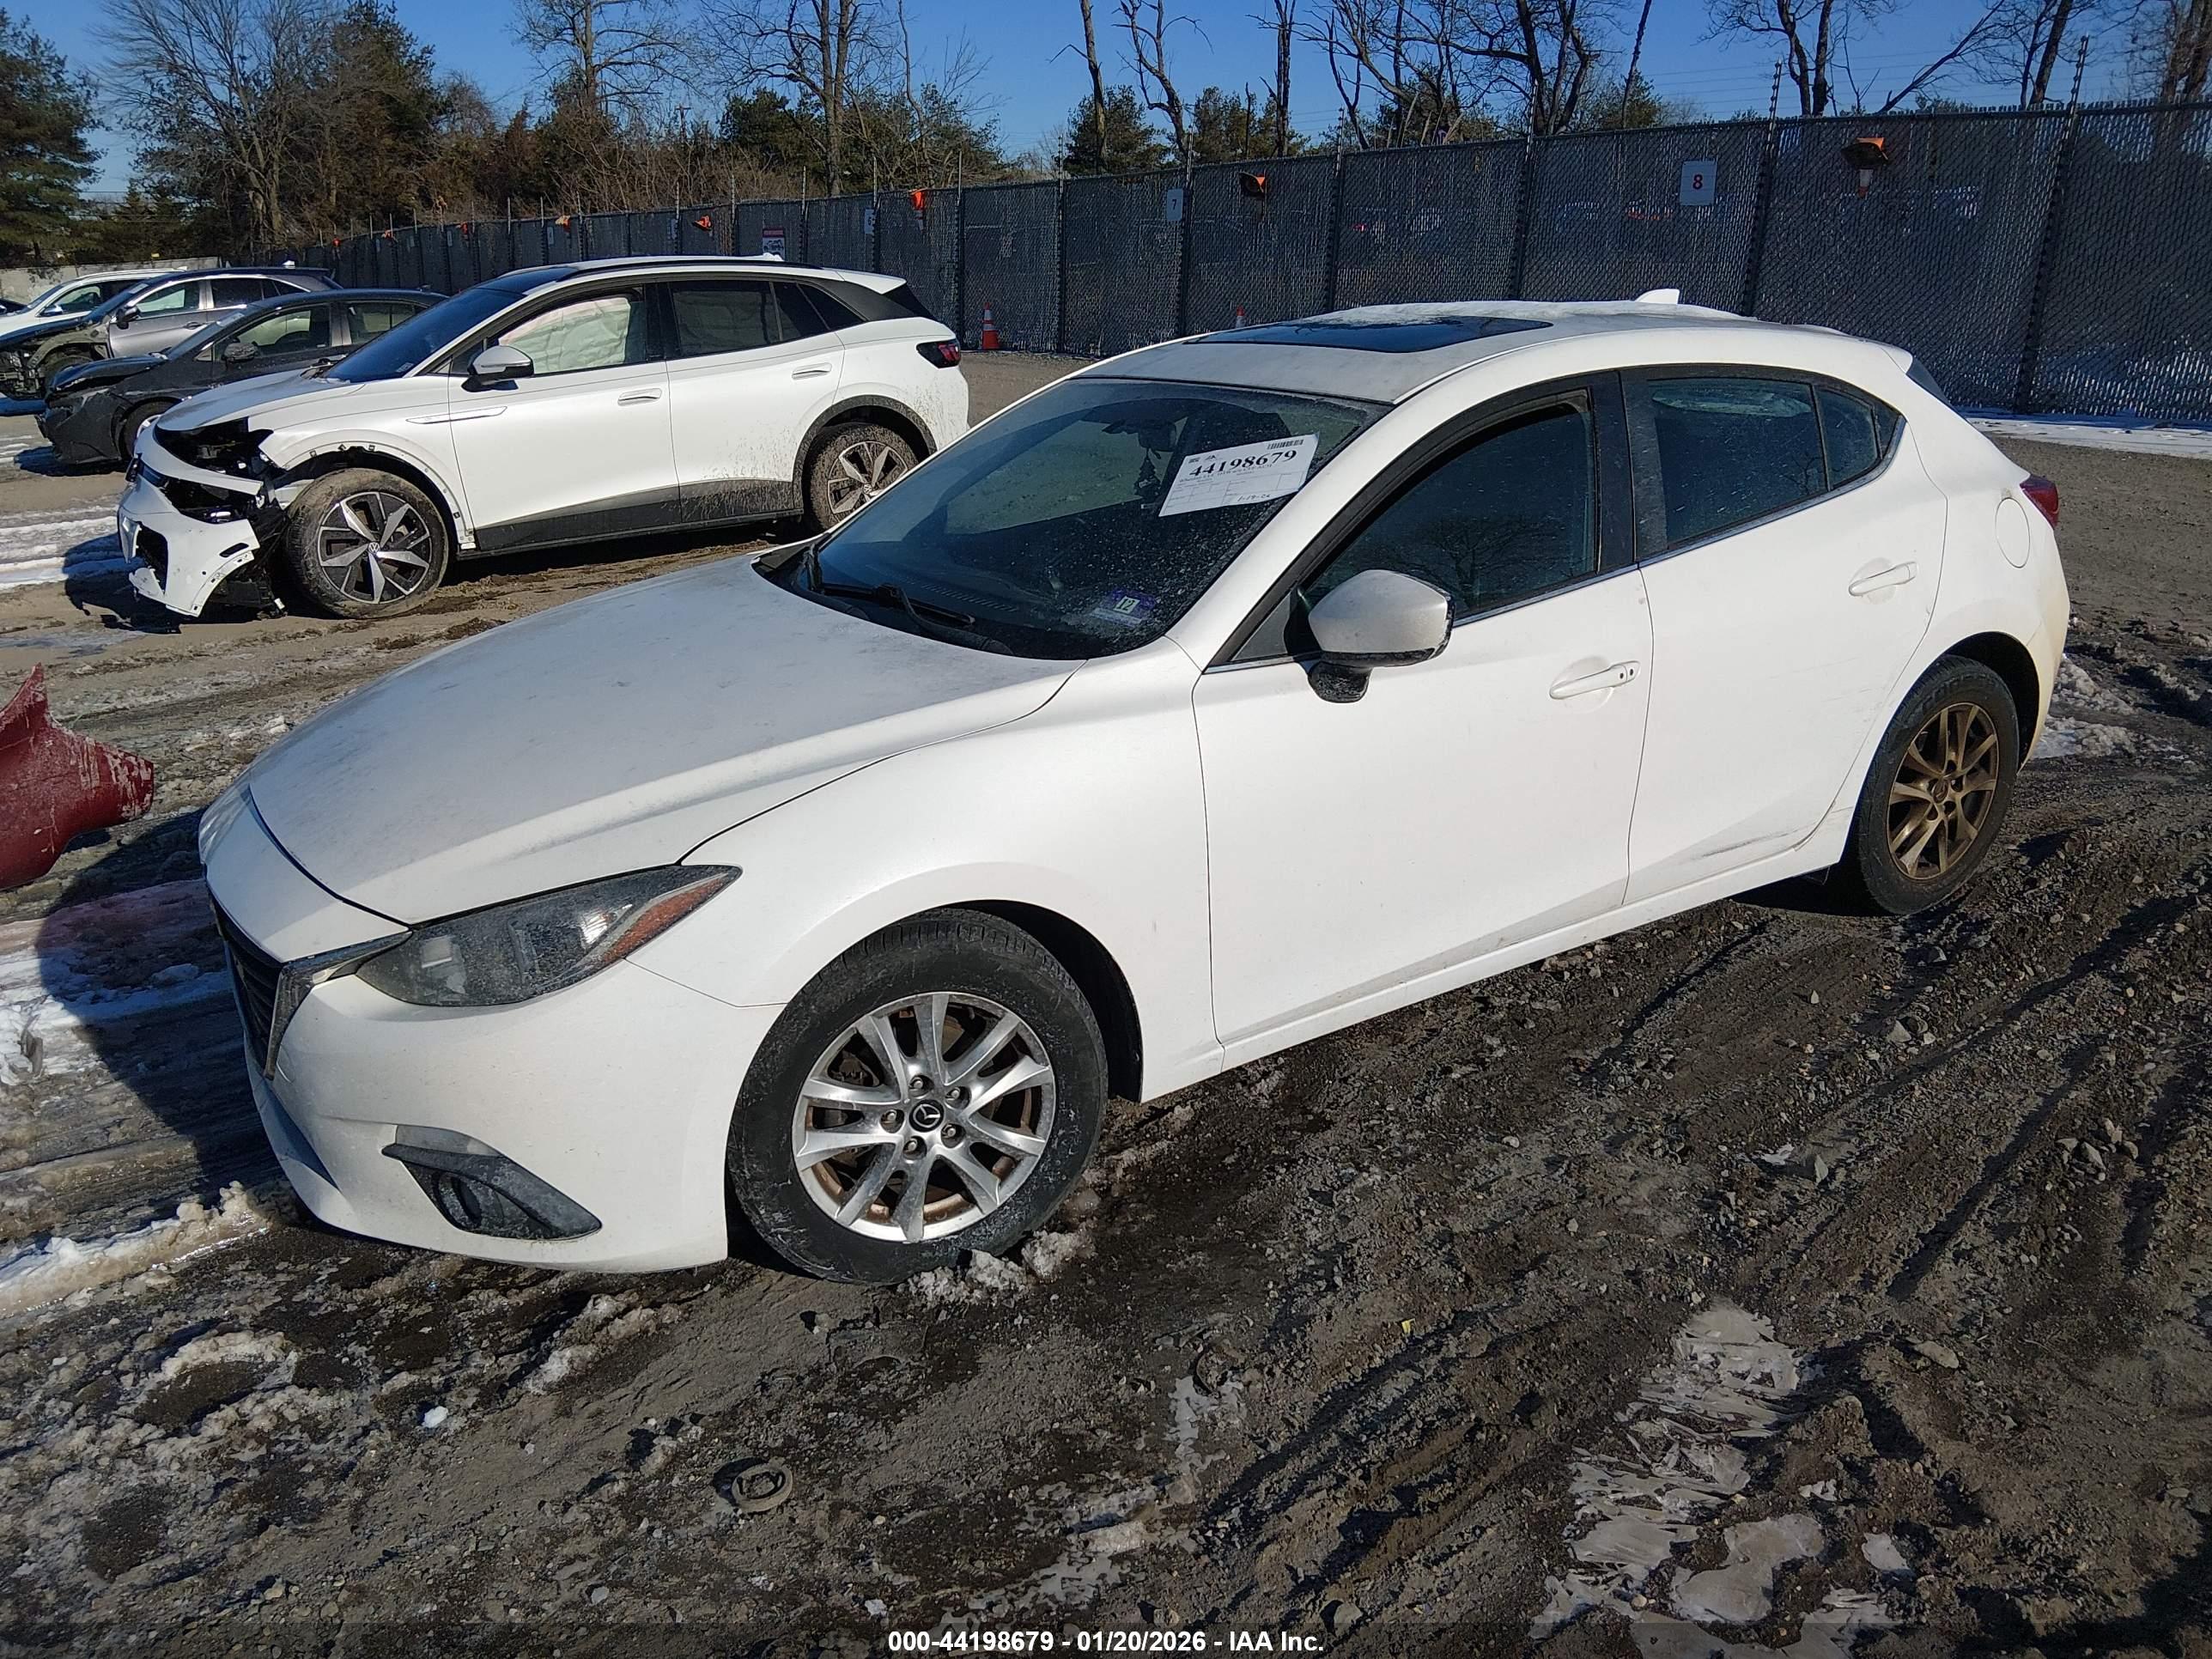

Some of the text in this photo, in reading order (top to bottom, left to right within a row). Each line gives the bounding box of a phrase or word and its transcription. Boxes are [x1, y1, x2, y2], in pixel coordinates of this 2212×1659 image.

[1692, 173, 1704, 191] 8
[1171, 198, 1177, 210] 7
[1189, 449, 1297, 477] 44198679
[1116, 598, 1135, 611] 12
